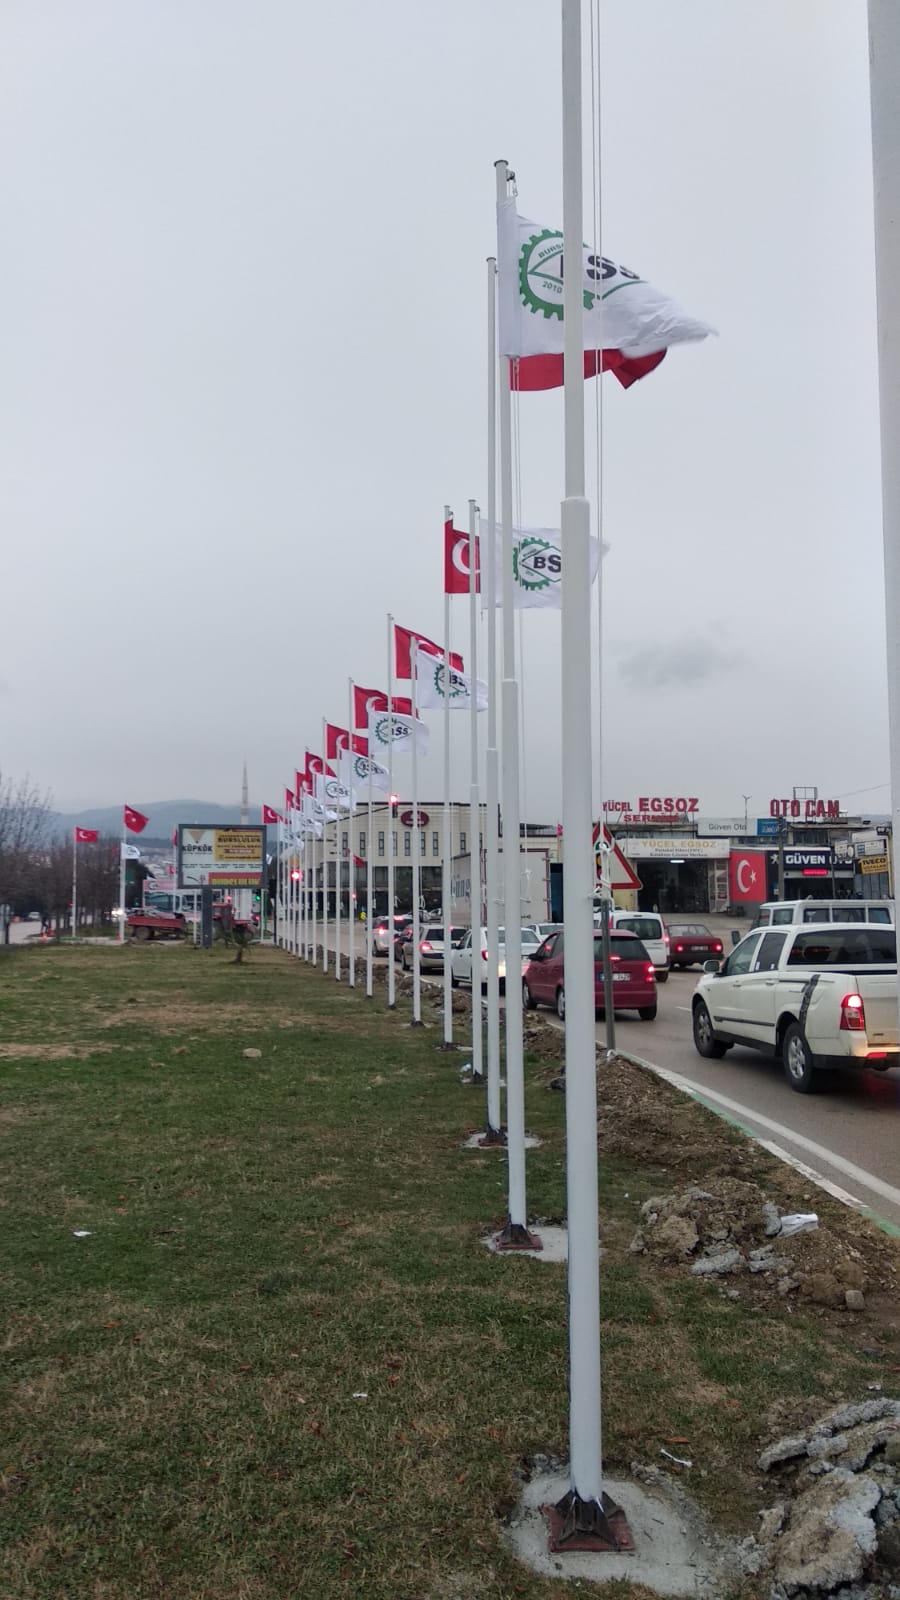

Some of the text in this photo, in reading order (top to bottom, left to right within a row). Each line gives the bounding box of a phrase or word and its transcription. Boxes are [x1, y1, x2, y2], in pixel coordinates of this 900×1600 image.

[541, 281, 562, 294] 2010
[533, 554, 562, 573] BS
[602, 797, 699, 812] YÜCEL EGSOZ
[770, 799, 840, 818] OTO CAM
[641, 840, 717, 848] YÜCEL EGSOZ
[785, 852, 826, 865] GÜVEN
